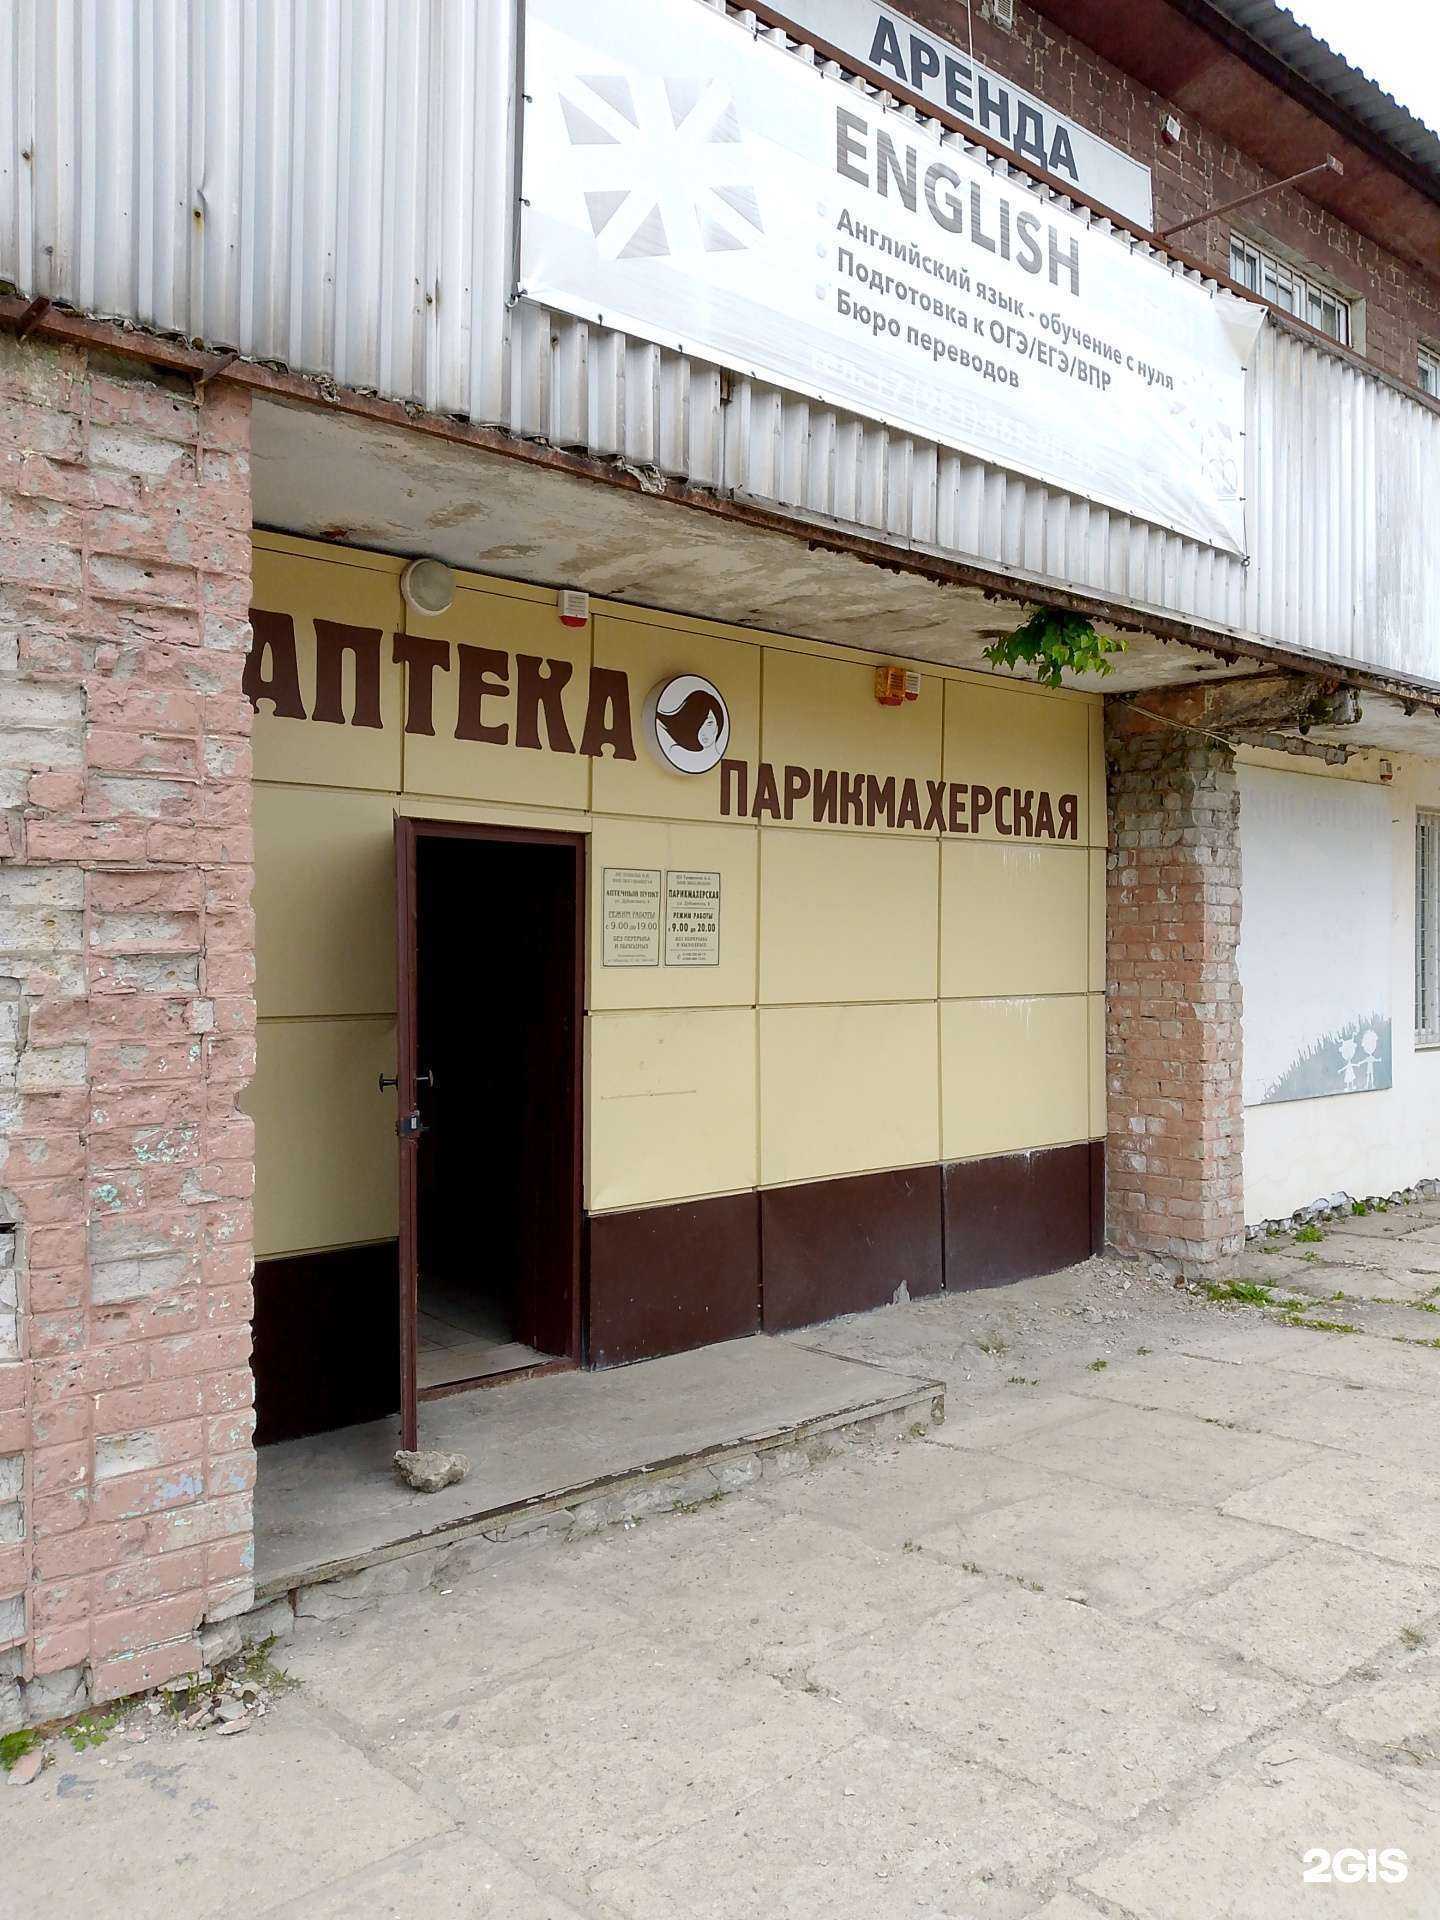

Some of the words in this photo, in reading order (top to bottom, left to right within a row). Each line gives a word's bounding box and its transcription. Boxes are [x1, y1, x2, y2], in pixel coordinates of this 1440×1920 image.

[868, 15, 1080, 182] АРЕНДА
[836, 105, 1080, 297] ENGLISH
[836, 208, 971, 293] Английский
[976, 281, 1025, 319] язык
[1039, 312, 1122, 365] обучение
[1126, 355, 1135, 372] с
[1137, 359, 1174, 391] нуля
[837, 246, 968, 329] Подготовка
[972, 316, 985, 337] к
[989, 319, 1112, 392] ОГЭ/ЕГЭ/ВПР
[837, 287, 901, 337] Бюро
[906, 325, 1020, 388] переводов
[241, 607, 637, 761] АПТЕКА
[719, 758, 1078, 841] ПАРИКМАХЕРСКАЯ
[671, 922, 689, 932] 9.00
[697, 922, 716, 933] 20.00
